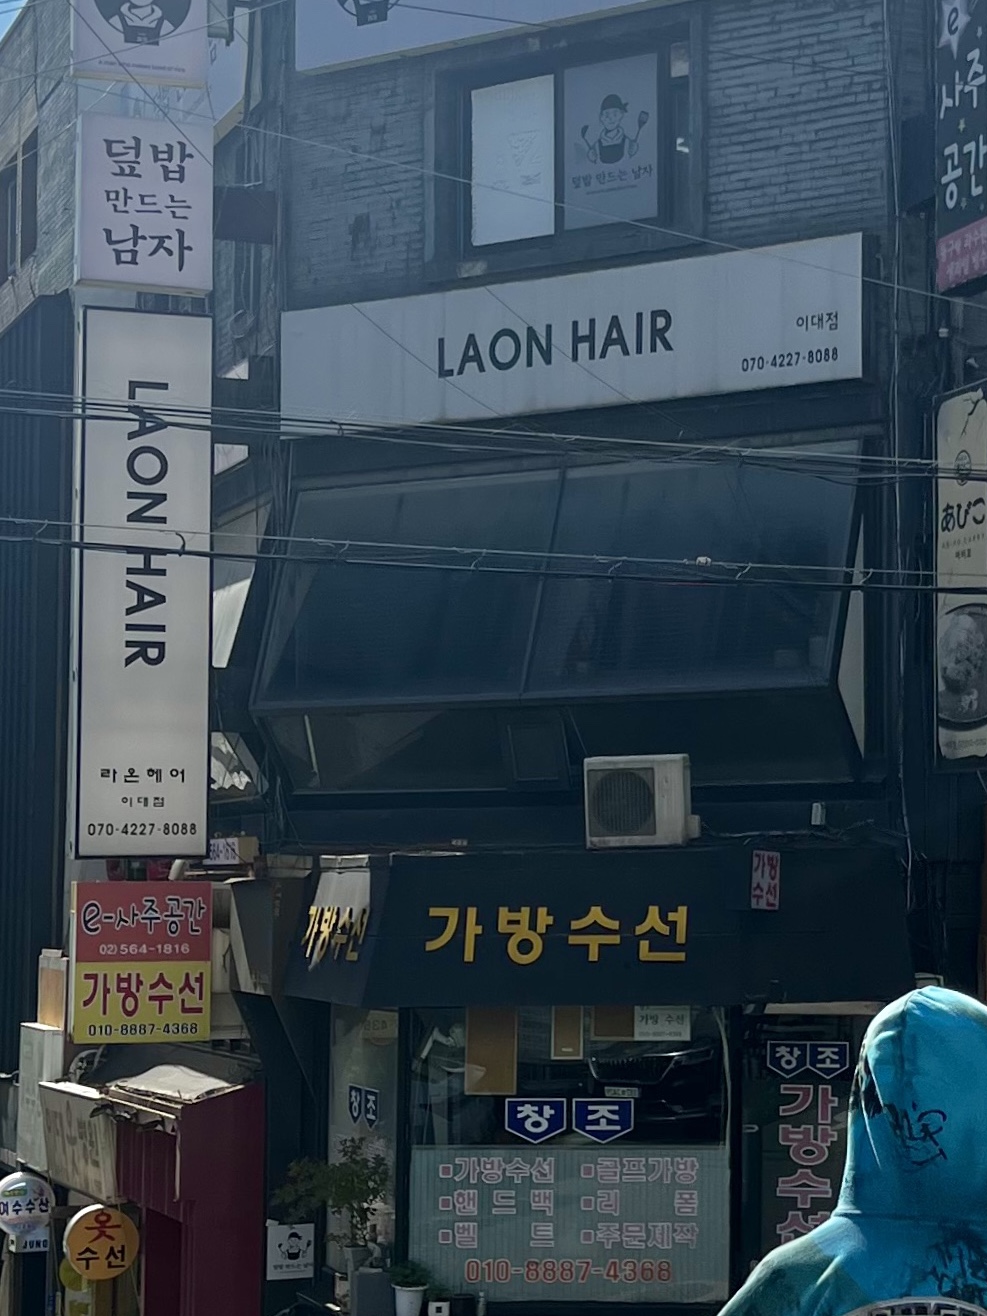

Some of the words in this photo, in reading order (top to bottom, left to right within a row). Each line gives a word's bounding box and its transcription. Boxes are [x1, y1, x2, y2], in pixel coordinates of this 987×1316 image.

[940, 48, 987, 120] 사주
[103, 136, 194, 184] 덮밥
[104, 187, 193, 220] 만드는
[102, 223, 194, 273] 남자
[796, 310, 839, 332] 이대점
[437, 323, 553, 379] LAON
[571, 308, 675, 363] HAIR
[126, 379, 170, 525] LAON
[941, 497, 986, 533] あびこ
[124, 549, 168, 668] HAIR
[100, 767, 185, 784] 라온헤어
[121, 796, 165, 808] 이대점
[754, 852, 778, 881] 가방
[752, 882, 777, 908] 수선
[425, 905, 689, 965] 가방수선
[82, 971, 206, 1018] 가방수선
[88, 1022, 198, 1036] 010-8887-4368
[775, 1045, 841, 1070] 창조
[516, 1103, 622, 1133] 창조
[454, 1157, 555, 1184] 가방수선
[596, 1157, 699, 1184] 골프가방
[84, 1208, 122, 1244] 옷
[596, 1222, 699, 1250] 주문제작
[76, 1244, 126, 1271] 수선
[465, 1258, 672, 1285] 010-8887-4368
